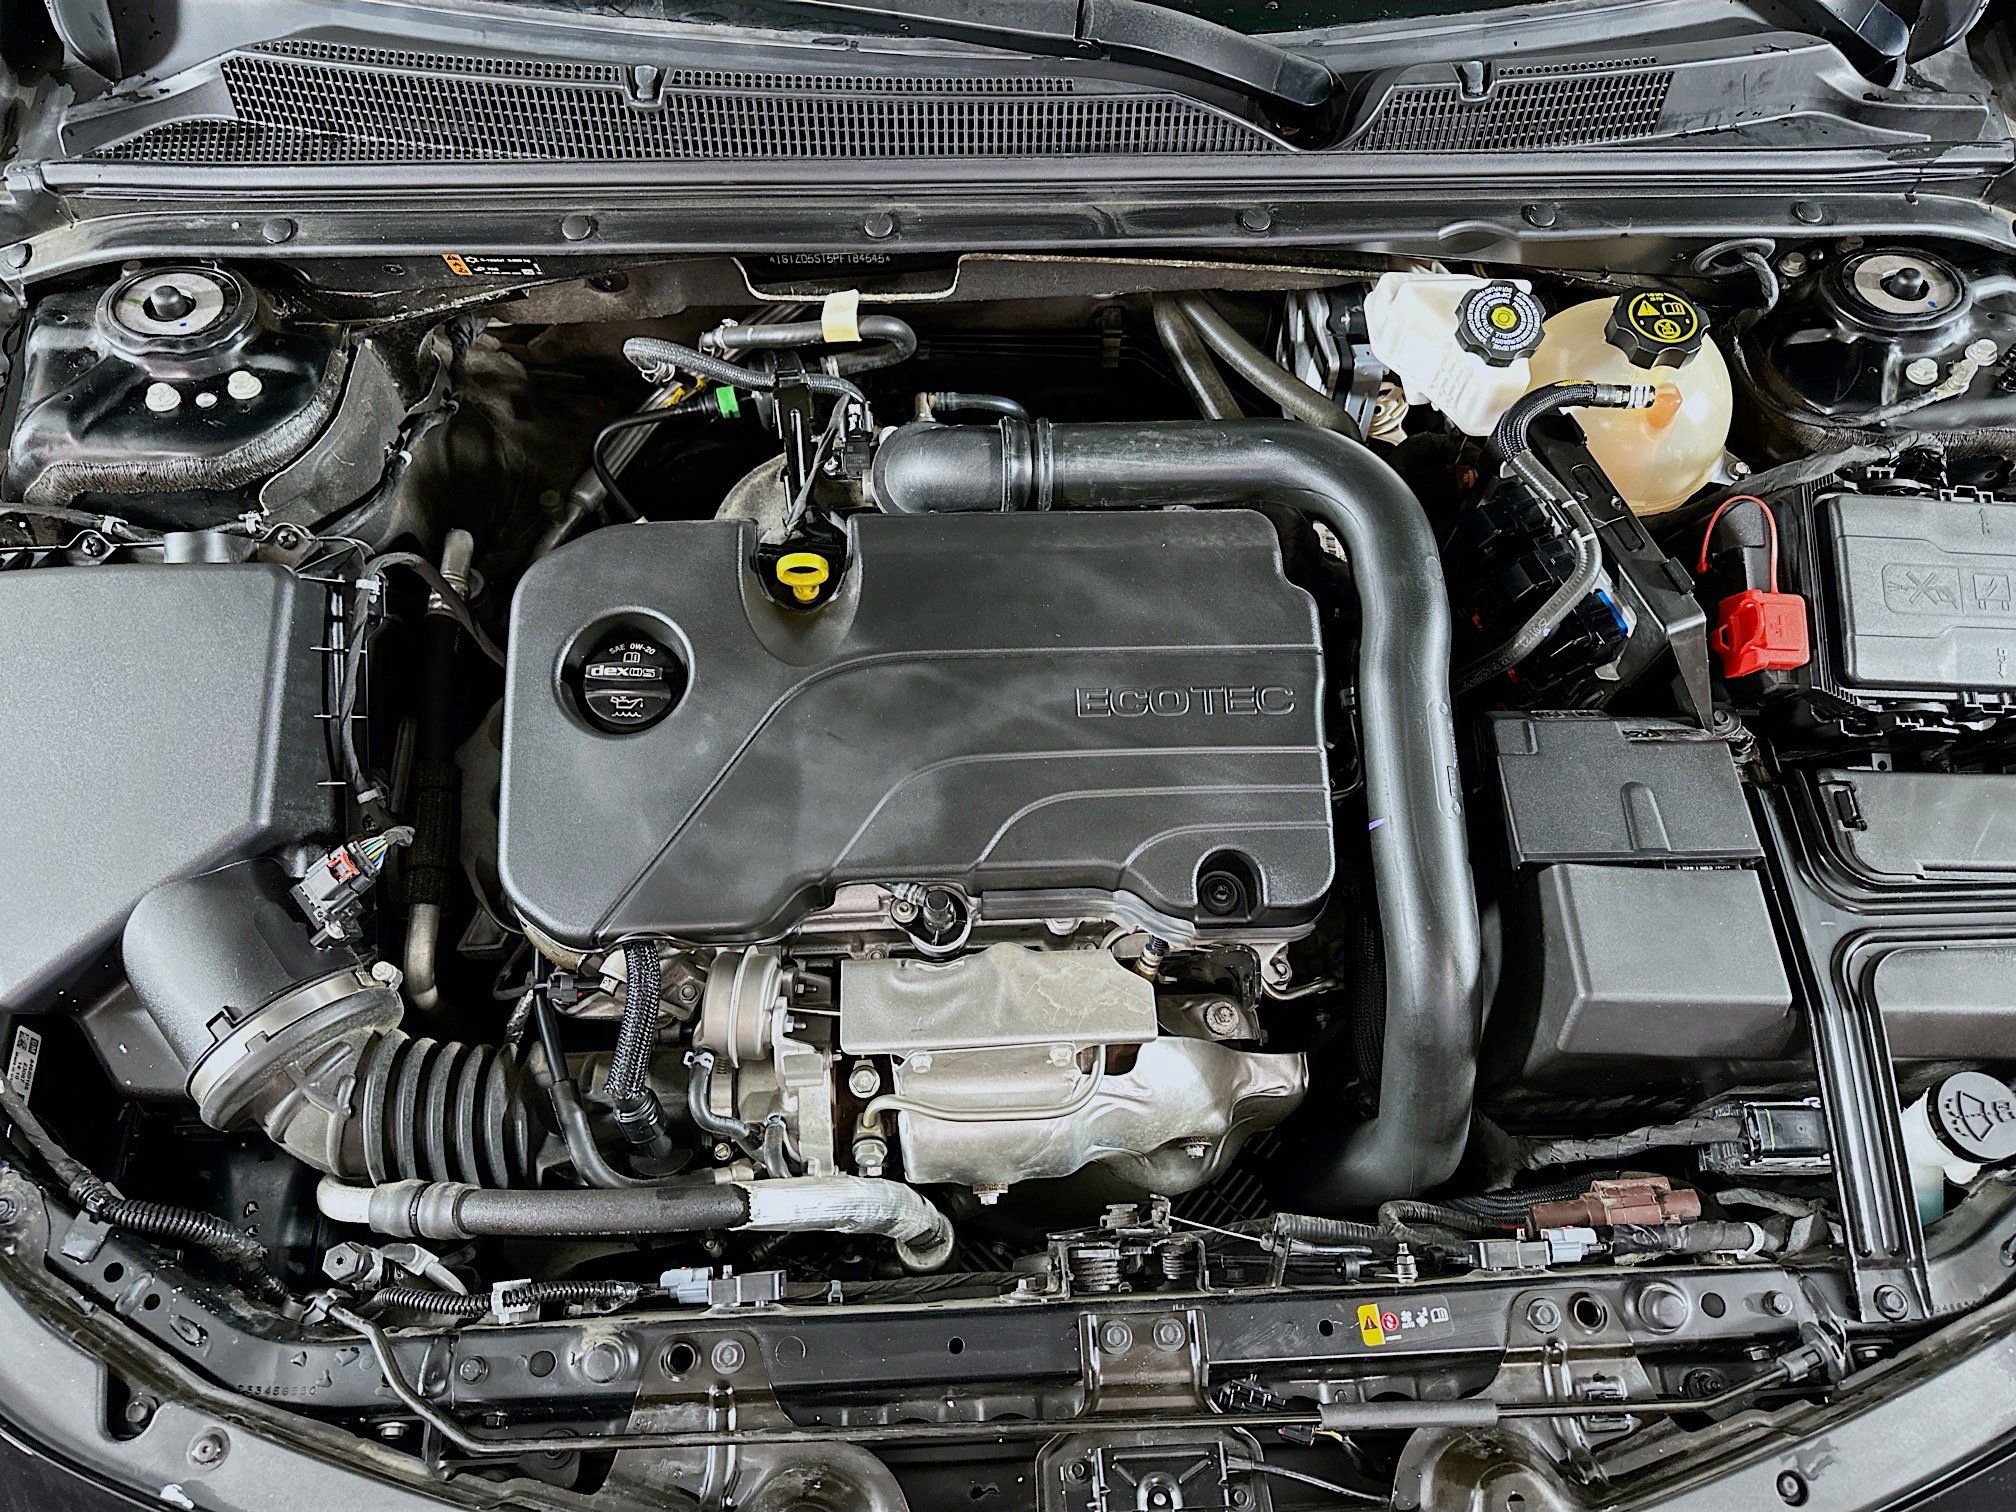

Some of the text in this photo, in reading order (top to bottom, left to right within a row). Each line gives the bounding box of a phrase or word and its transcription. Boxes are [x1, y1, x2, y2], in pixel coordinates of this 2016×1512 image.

[608, 642, 656, 655] SAE 0W-20
[590, 664, 656, 678] dexos
[1075, 685, 1295, 718] ECOTEC
[29, 1038, 39, 1054] GM
